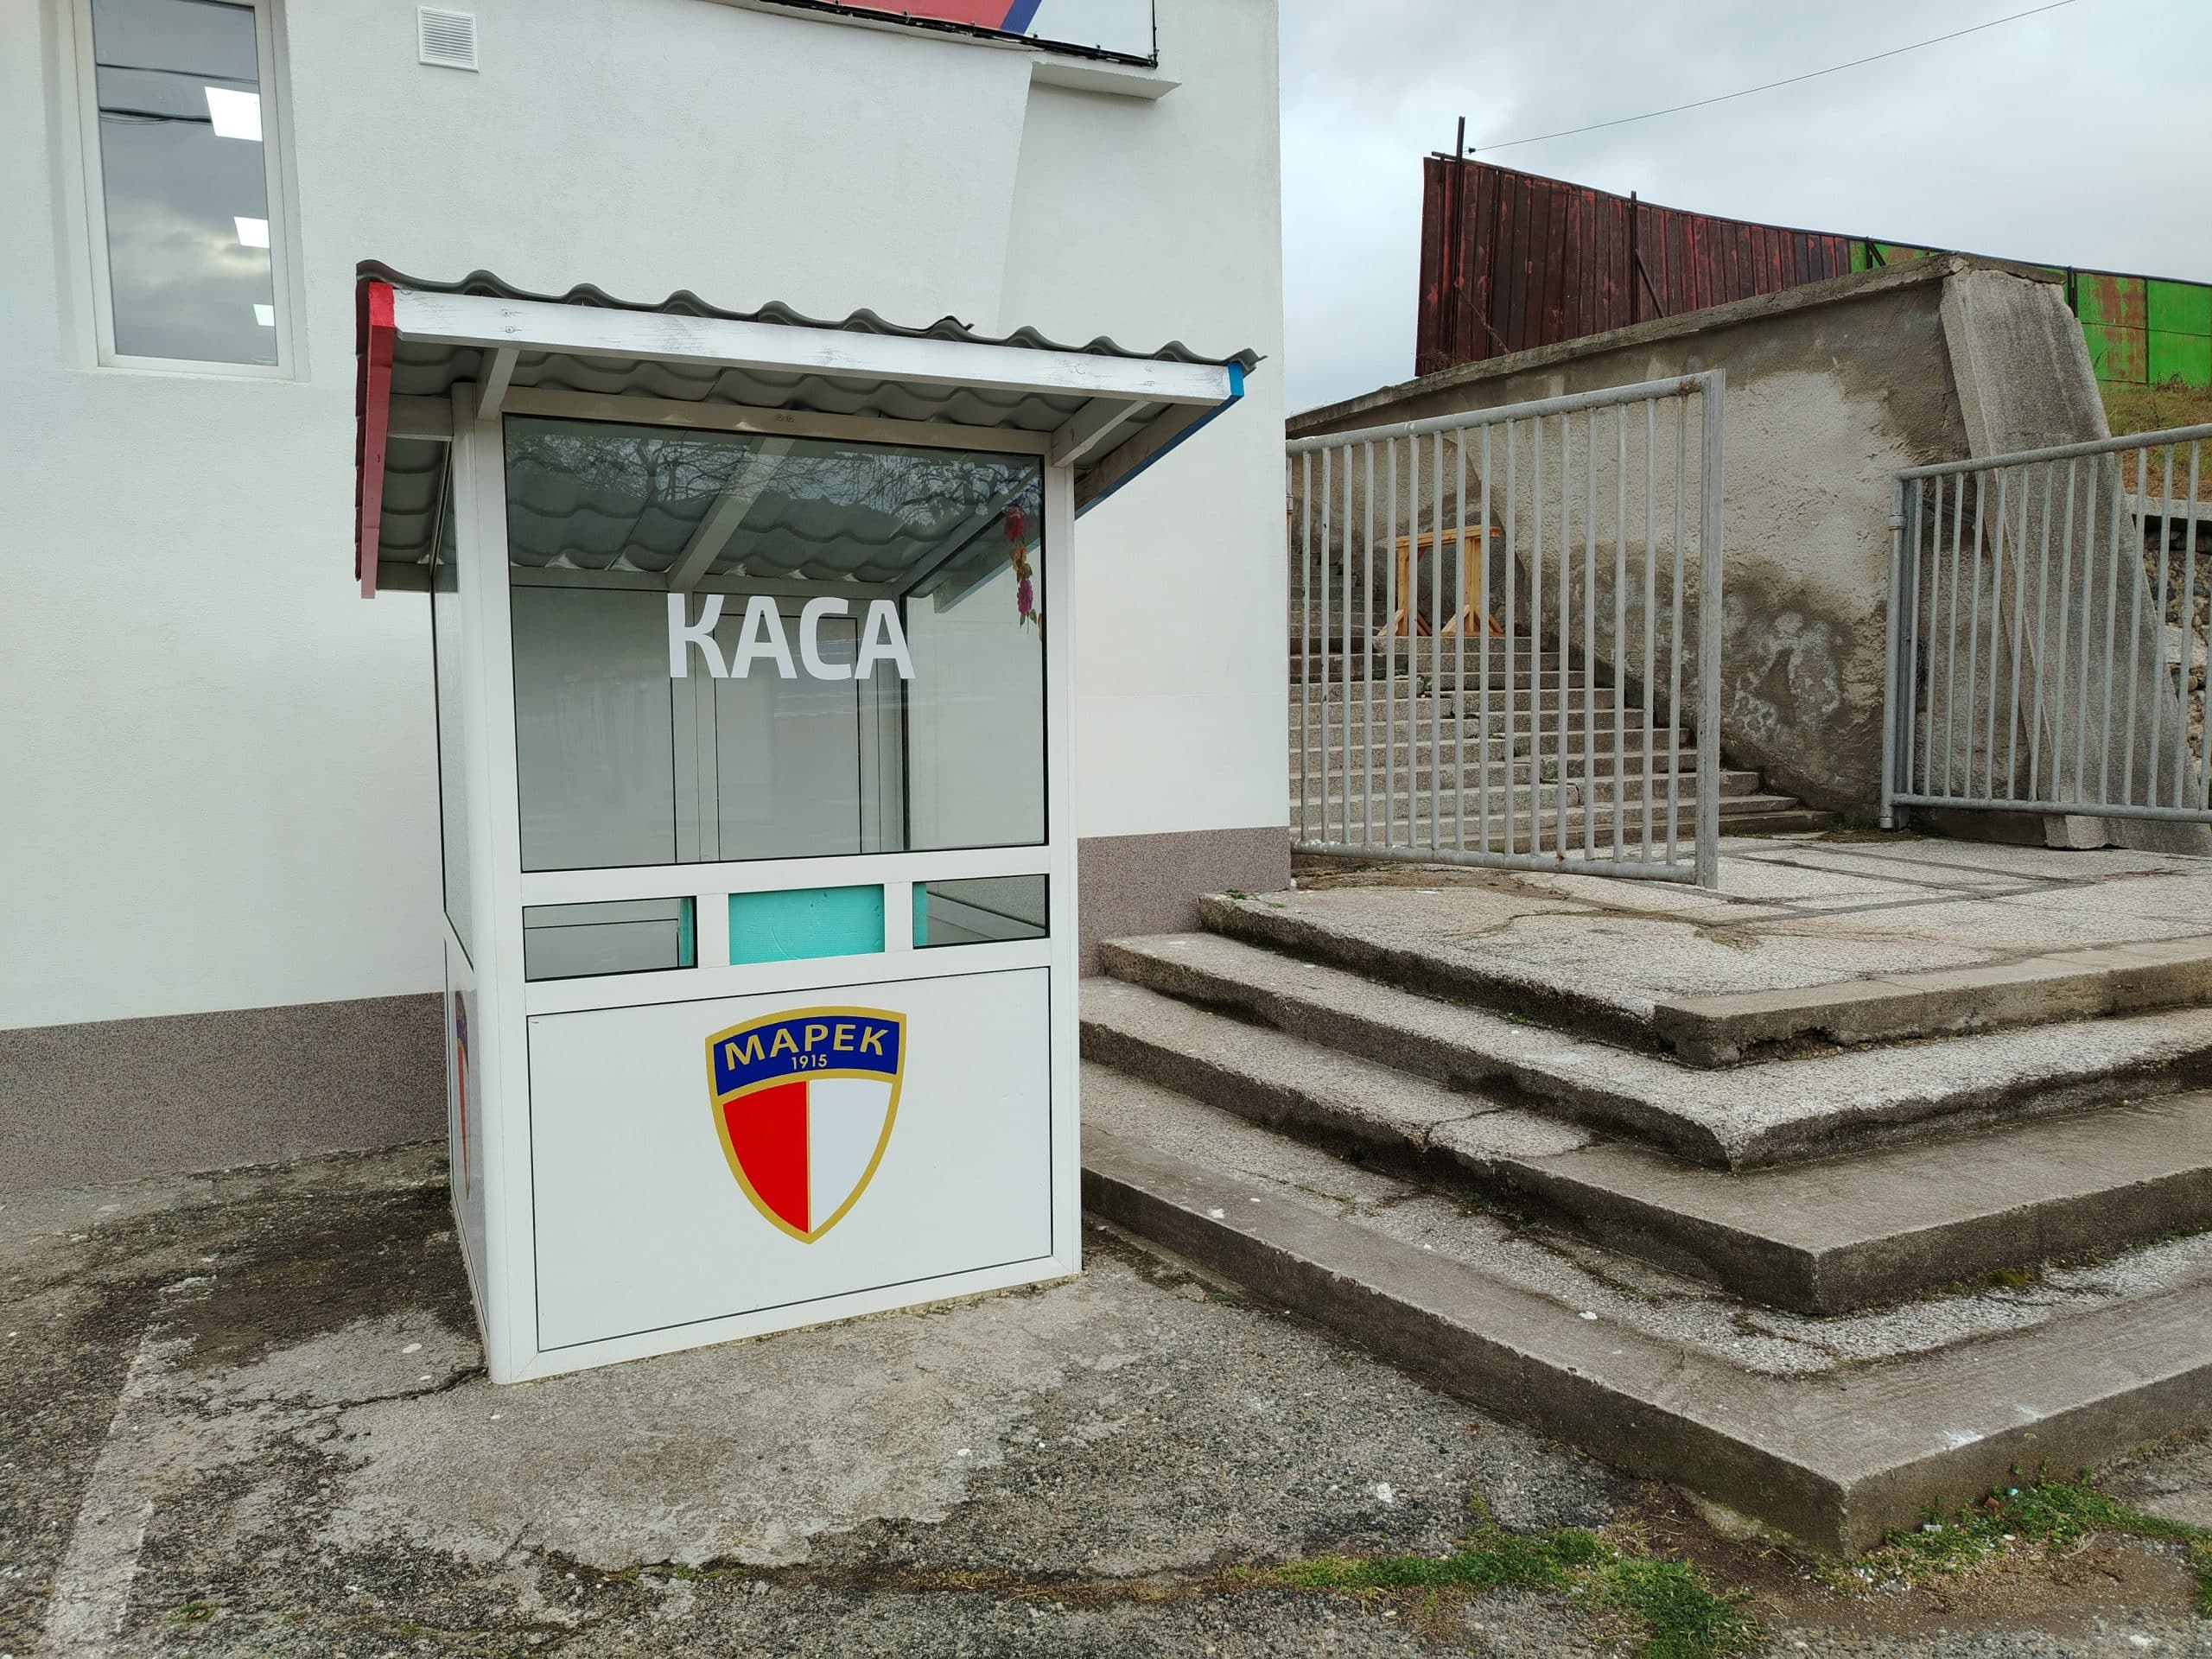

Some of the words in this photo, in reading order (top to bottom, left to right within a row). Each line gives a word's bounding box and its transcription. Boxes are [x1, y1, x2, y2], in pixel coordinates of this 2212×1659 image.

[667, 593, 916, 680] КАСА
[724, 1023, 889, 1071] МАРЕК
[791, 1053, 828, 1071] 1915
